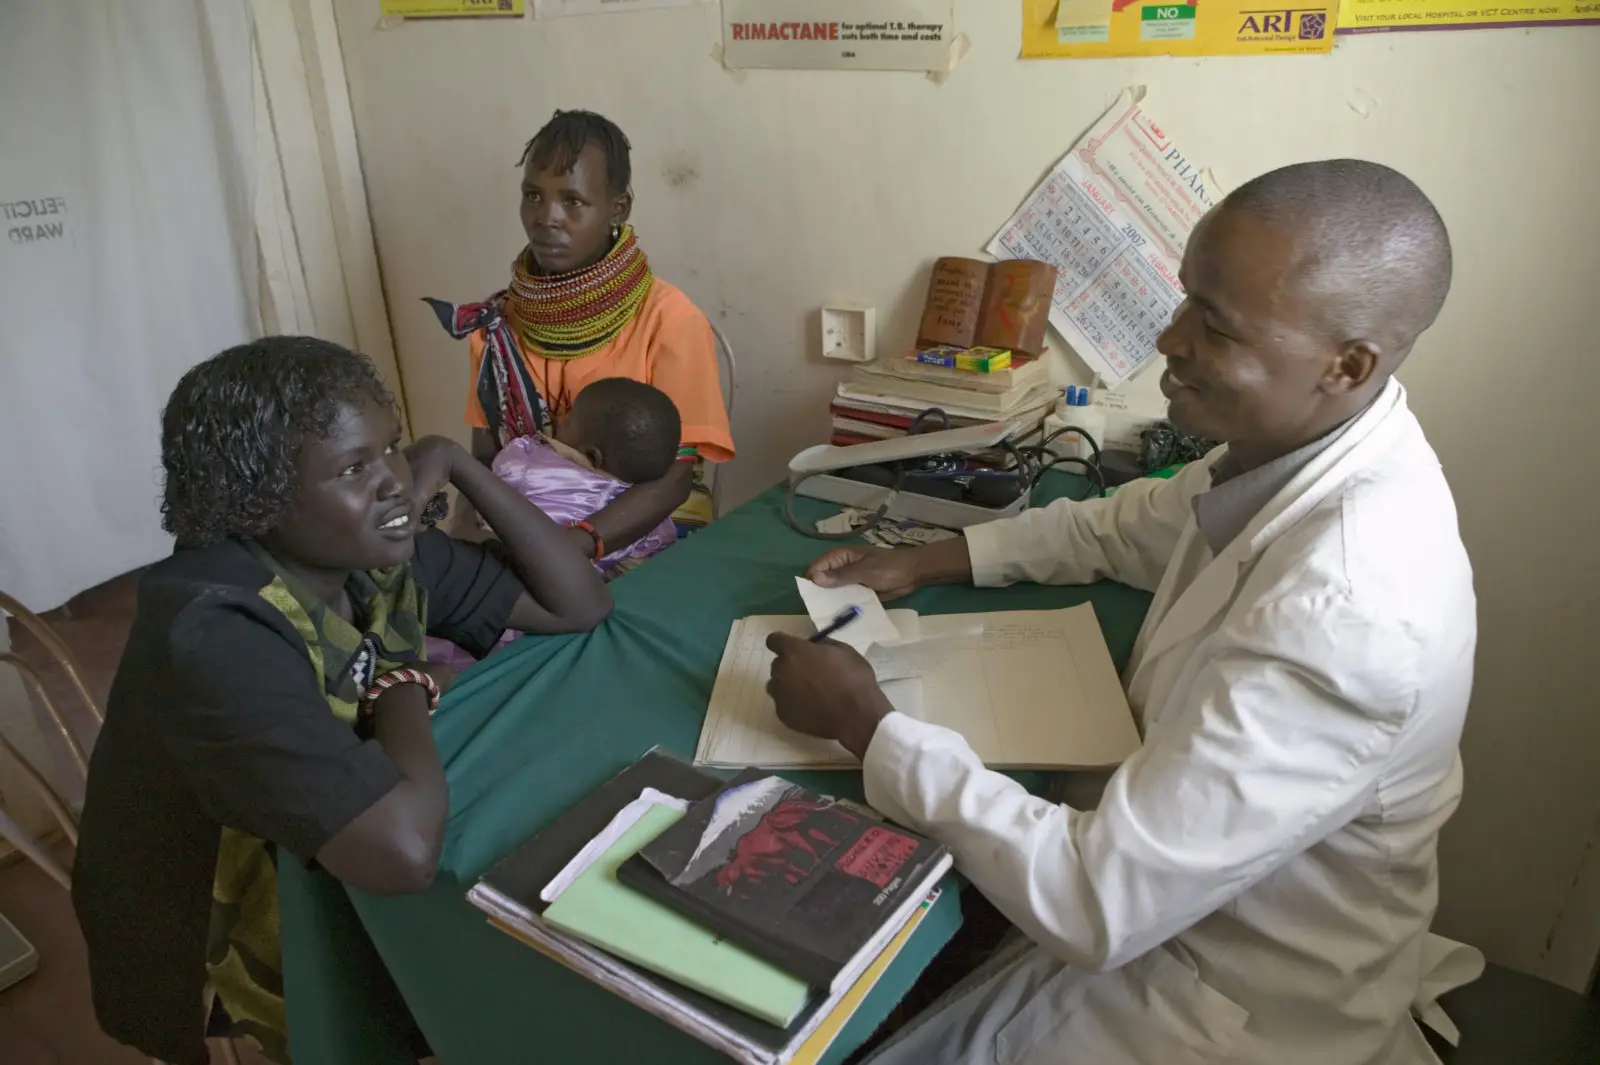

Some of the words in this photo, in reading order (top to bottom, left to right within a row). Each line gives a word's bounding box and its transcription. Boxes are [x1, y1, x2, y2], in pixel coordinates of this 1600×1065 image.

[1156, 7, 1179, 19] NO
[1238, 10, 1292, 34] ART
[1355, 14, 1374, 22] VISIT
[1377, 13, 1396, 21] YOUR
[1398, 12, 1422, 20] LOCAL
[1425, 11, 1464, 19] HOSPITAL
[1481, 8, 1498, 17] VCT
[1500, 8, 1536, 16] CENTRE
[732, 22, 839, 40] RIMACTANE
[842, 22, 853, 30] for
[855, 22, 887, 32] optimal
[908, 22, 943, 32] therapy
[860, 32, 879, 40] both
[881, 32, 899, 40] time
[901, 32, 918, 40] and
[920, 33, 942, 41] costs
[1081, 180, 1115, 213] JANUARY
[1024, 231, 1035, 242] 22
[1031, 239, 1043, 251] 23
[1064, 206, 1073, 215] 2
[1071, 215, 1081, 224] 3
[1081, 226, 1090, 235] 4
[1090, 236, 1100, 245] 5
[1099, 245, 1109, 255] 6
[1122, 223, 1146, 247] 2007
[1012, 242, 1024, 254] 29
[1034, 220, 1045, 231] 15
[1042, 229, 1054, 241] 16
[1051, 238, 1062, 248] 17
[1060, 248, 1071, 258] 18
[1069, 257, 1081, 268] 19
[1078, 267, 1090, 278] 20
[1061, 226, 1072, 238] 10
[1070, 237, 1080, 247] 11
[1088, 256, 1100, 268] 13
[1111, 280, 1120, 289] 5
[1120, 291, 1128, 299] 6
[1137, 310, 1146, 319] 8
[1100, 290, 1111, 301] 12
[1108, 300, 1119, 311] 13
[1117, 309, 1128, 320] 14
[1126, 320, 1137, 331] 15
[1135, 330, 1146, 342] 16
[1143, 339, 1154, 351] 17
[1157, 309, 1168, 319] 2
[1076, 312, 1088, 324] 26
[1084, 321, 1096, 333] 27
[1092, 330, 1104, 343] 28
[1088, 302, 1099, 313] 19
[1096, 311, 1108, 323] 20
[1104, 320, 1115, 331] 21
[1113, 330, 1125, 342] 22
[1123, 341, 1134, 352] 23
[1131, 350, 1142, 362] 24
[923, 354, 945, 365] Trust
